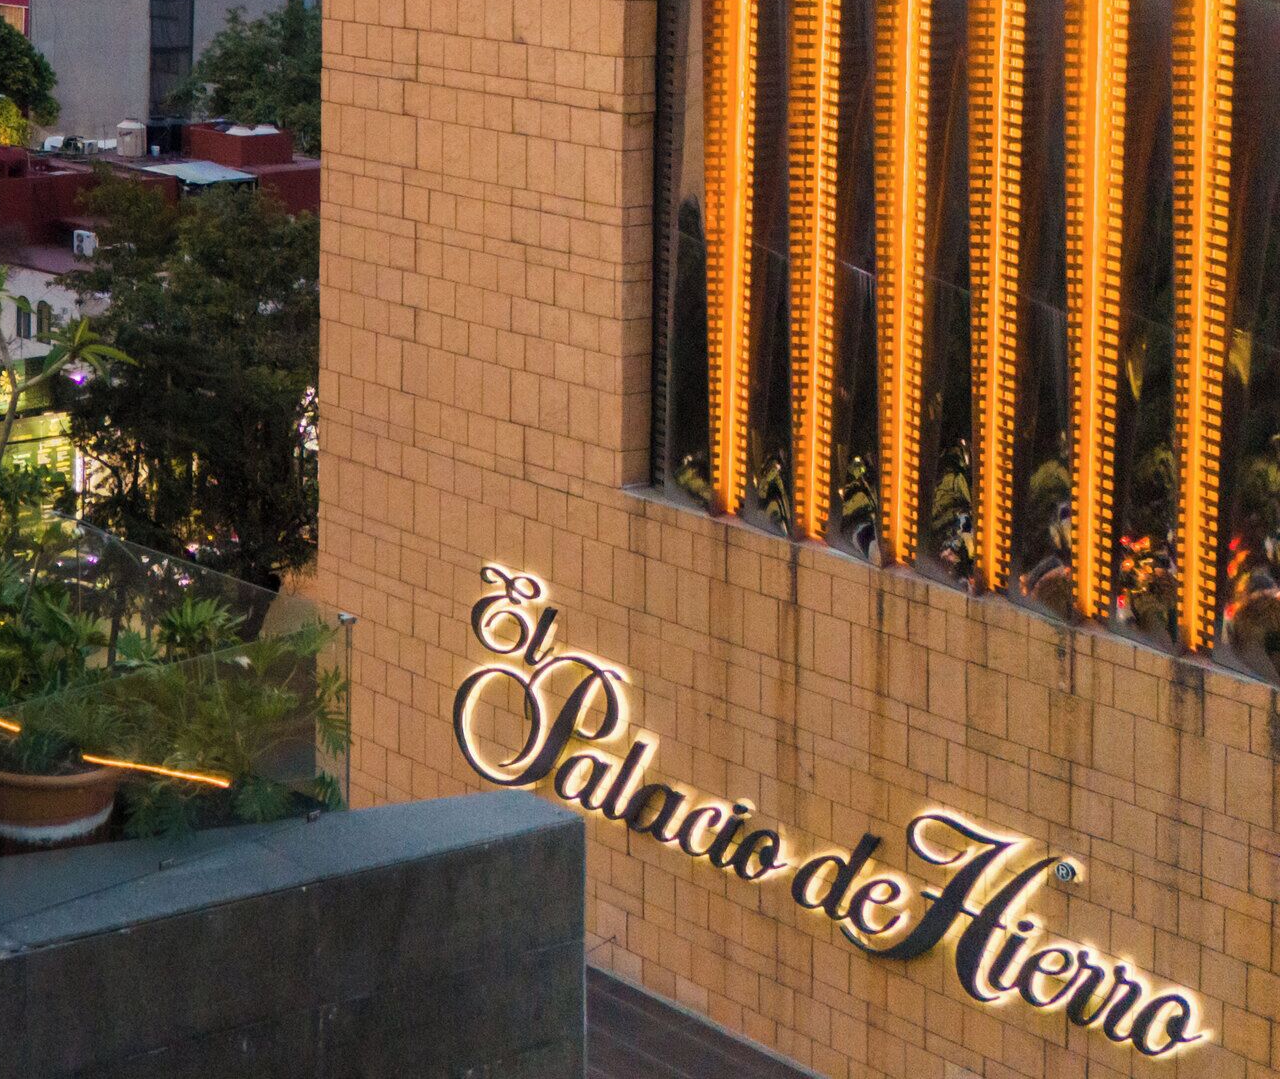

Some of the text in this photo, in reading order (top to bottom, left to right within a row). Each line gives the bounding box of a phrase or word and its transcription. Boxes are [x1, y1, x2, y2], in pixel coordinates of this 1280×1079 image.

[471, 565, 558, 666] El
[452, 655, 787, 880] Palacio
[791, 832, 901, 935] de
